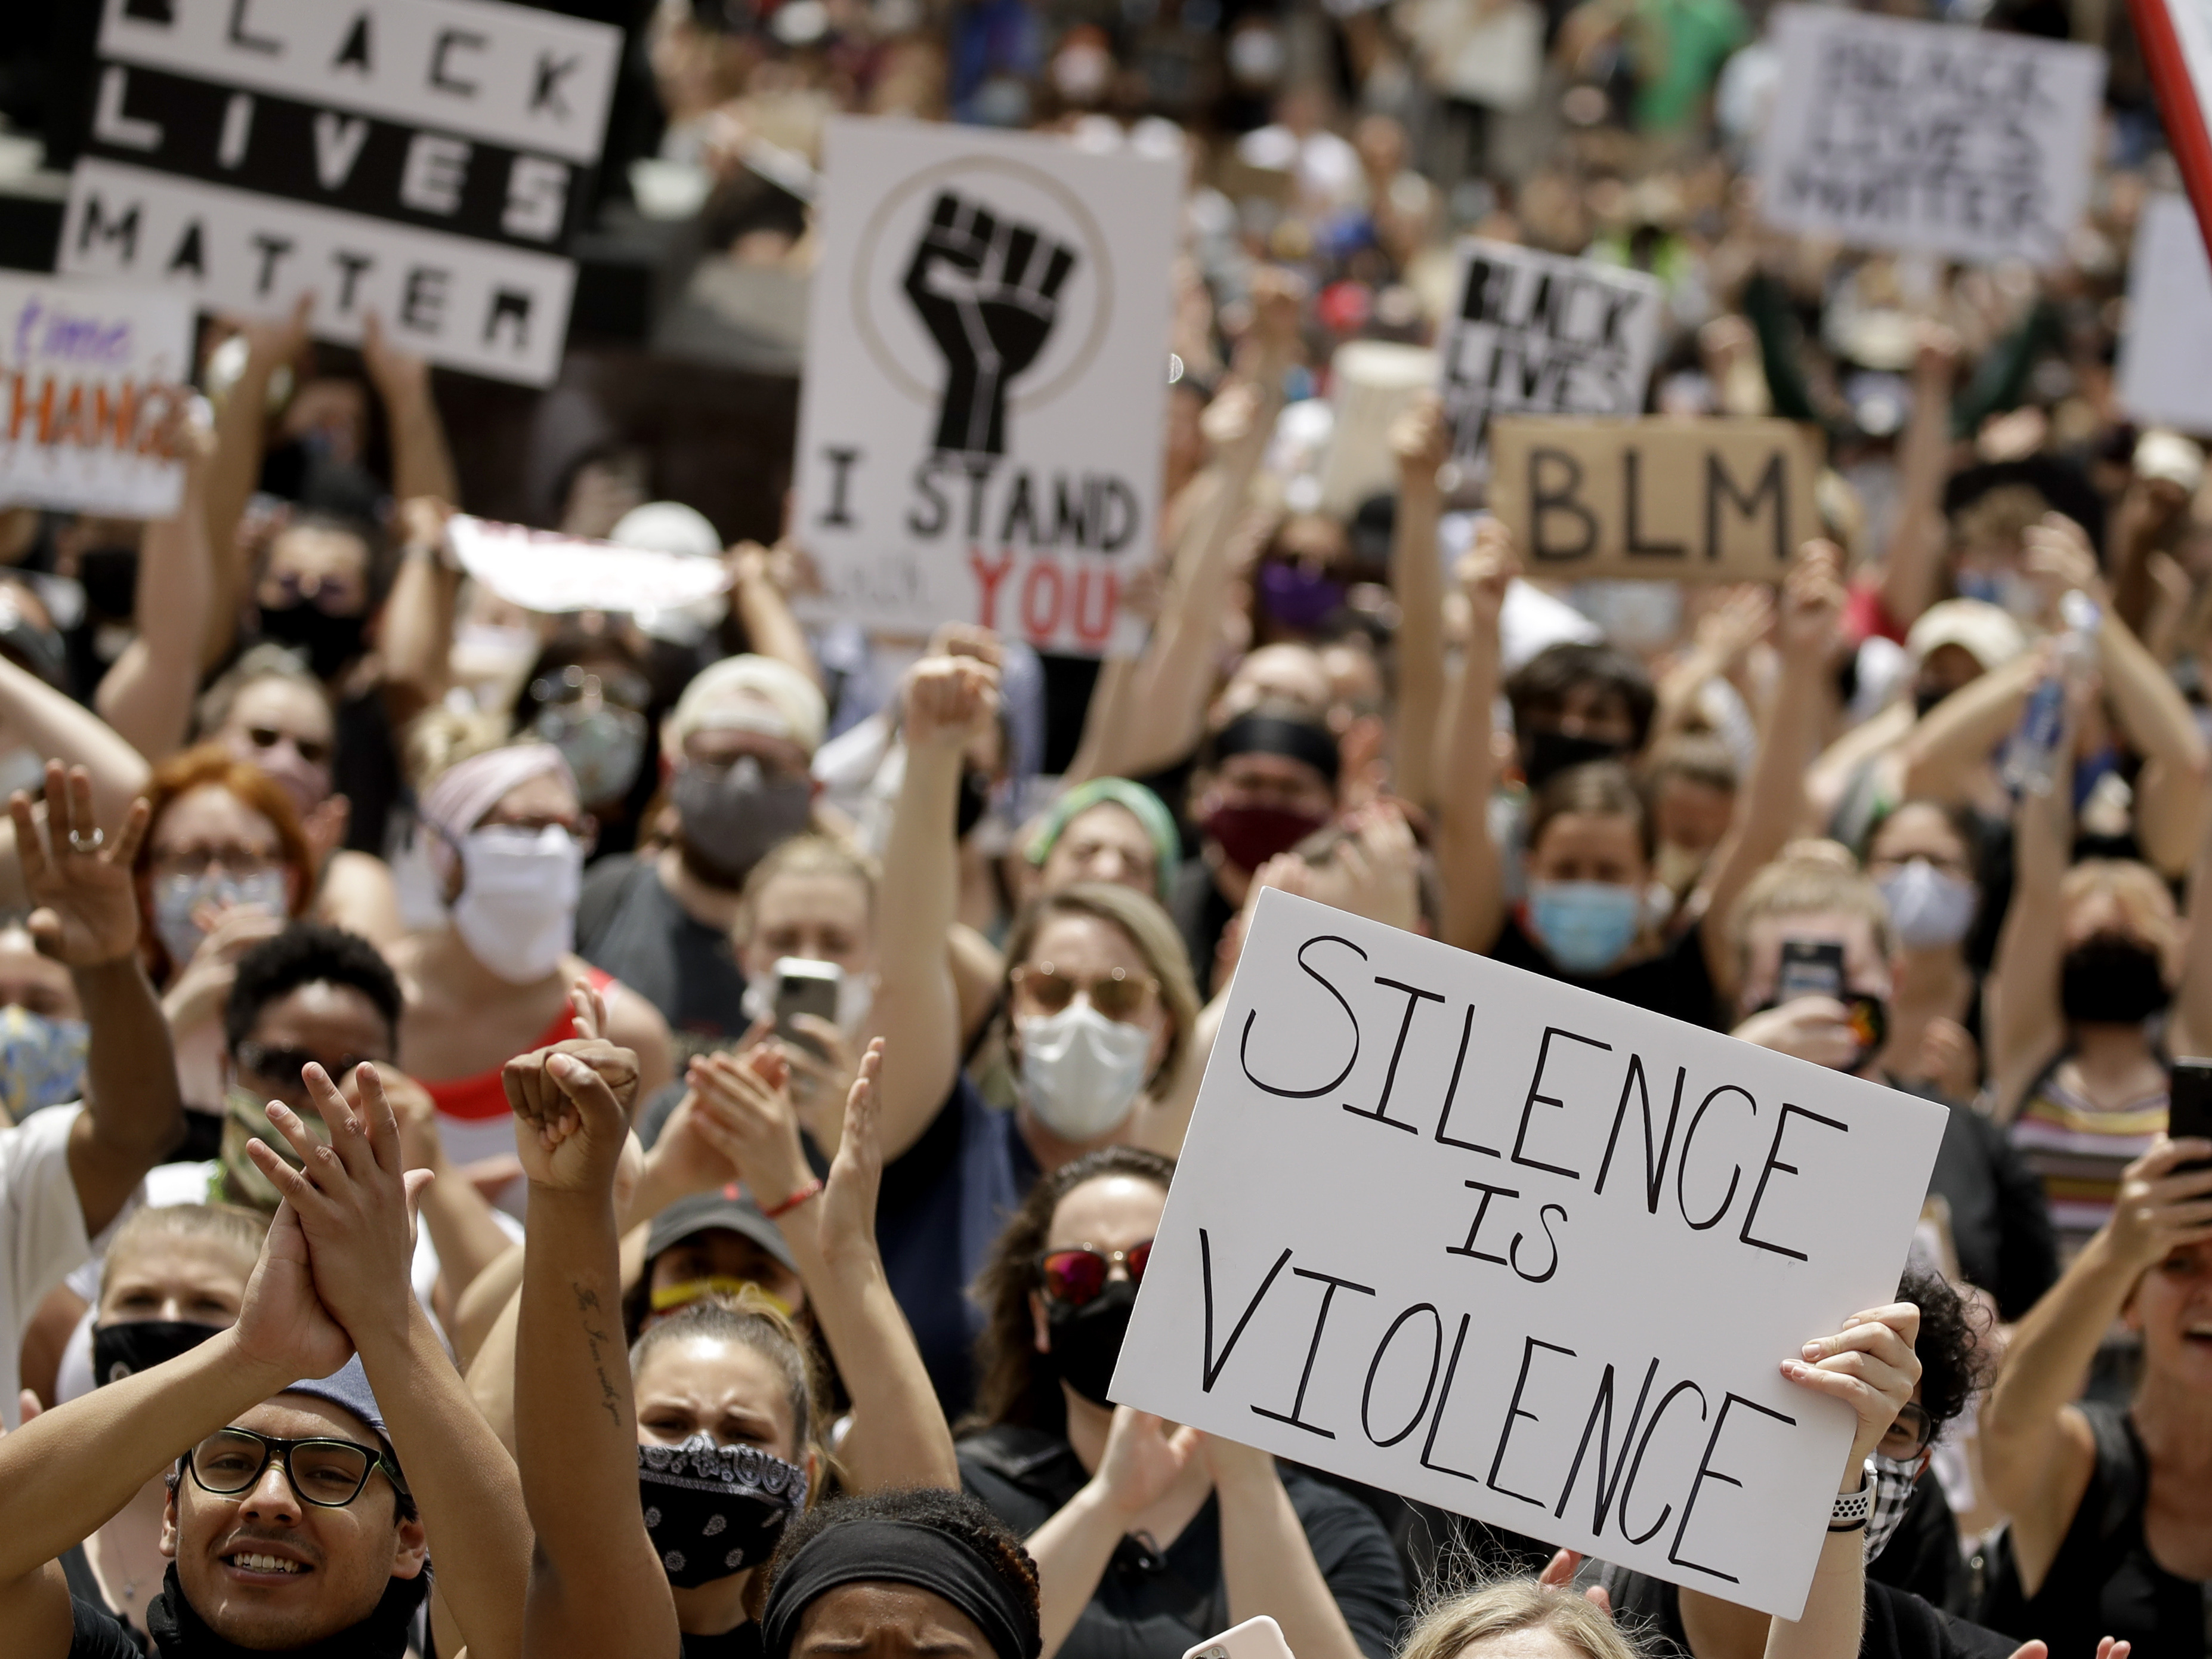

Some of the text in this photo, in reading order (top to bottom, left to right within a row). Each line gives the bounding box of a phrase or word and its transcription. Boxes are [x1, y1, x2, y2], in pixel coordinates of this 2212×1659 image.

[95, 66, 570, 240] LIVES
[76, 192, 532, 351] MATTER
[1462, 258, 1645, 352] BLACK
[1444, 327, 1633, 414] LIVES
[818, 447, 1142, 554] I STAND
[1527, 446, 1788, 562] BLM
[971, 549, 1122, 648] YOU
[1241, 936, 1848, 1261] SILENCE
[1446, 1180, 1567, 1283] IS
[1199, 1228, 1796, 1584] VIOLENCE
